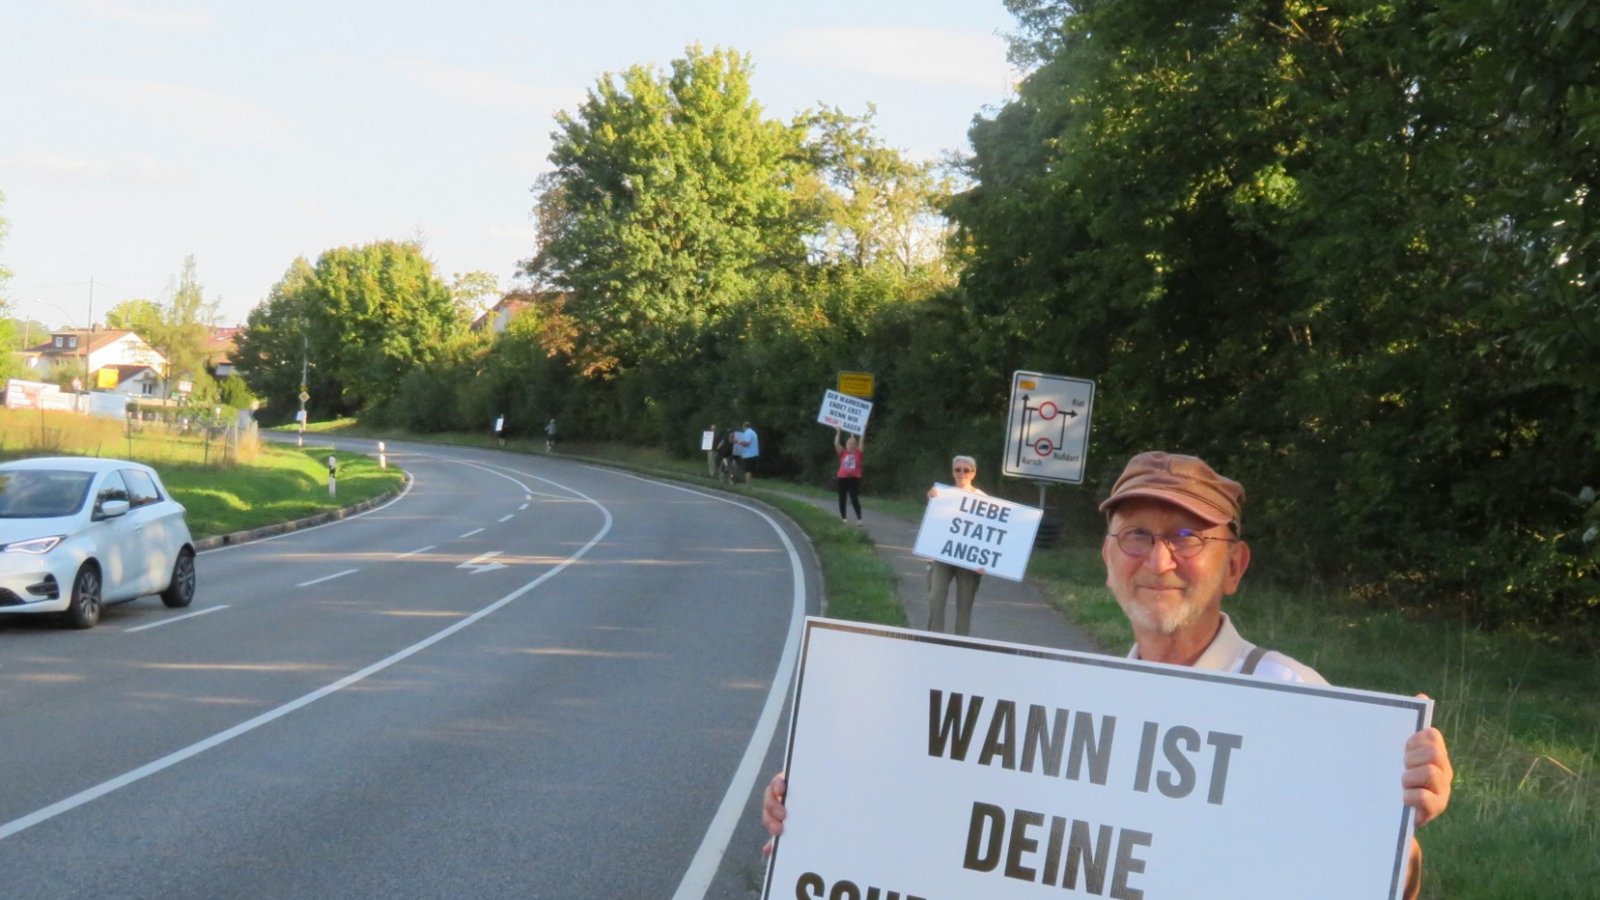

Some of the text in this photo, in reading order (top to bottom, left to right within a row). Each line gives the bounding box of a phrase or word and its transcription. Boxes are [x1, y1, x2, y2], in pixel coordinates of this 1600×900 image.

[827, 392, 838, 401] DER
[829, 401, 847, 411] ENDET
[829, 409, 846, 419] WENN
[843, 421, 861, 432] SAGEN
[959, 496, 1011, 523] LIEBE
[949, 517, 1008, 546] STATT
[940, 539, 1003, 568] ANGST
[928, 688, 1243, 805] WANN IST
[963, 801, 1153, 900] DEINE
